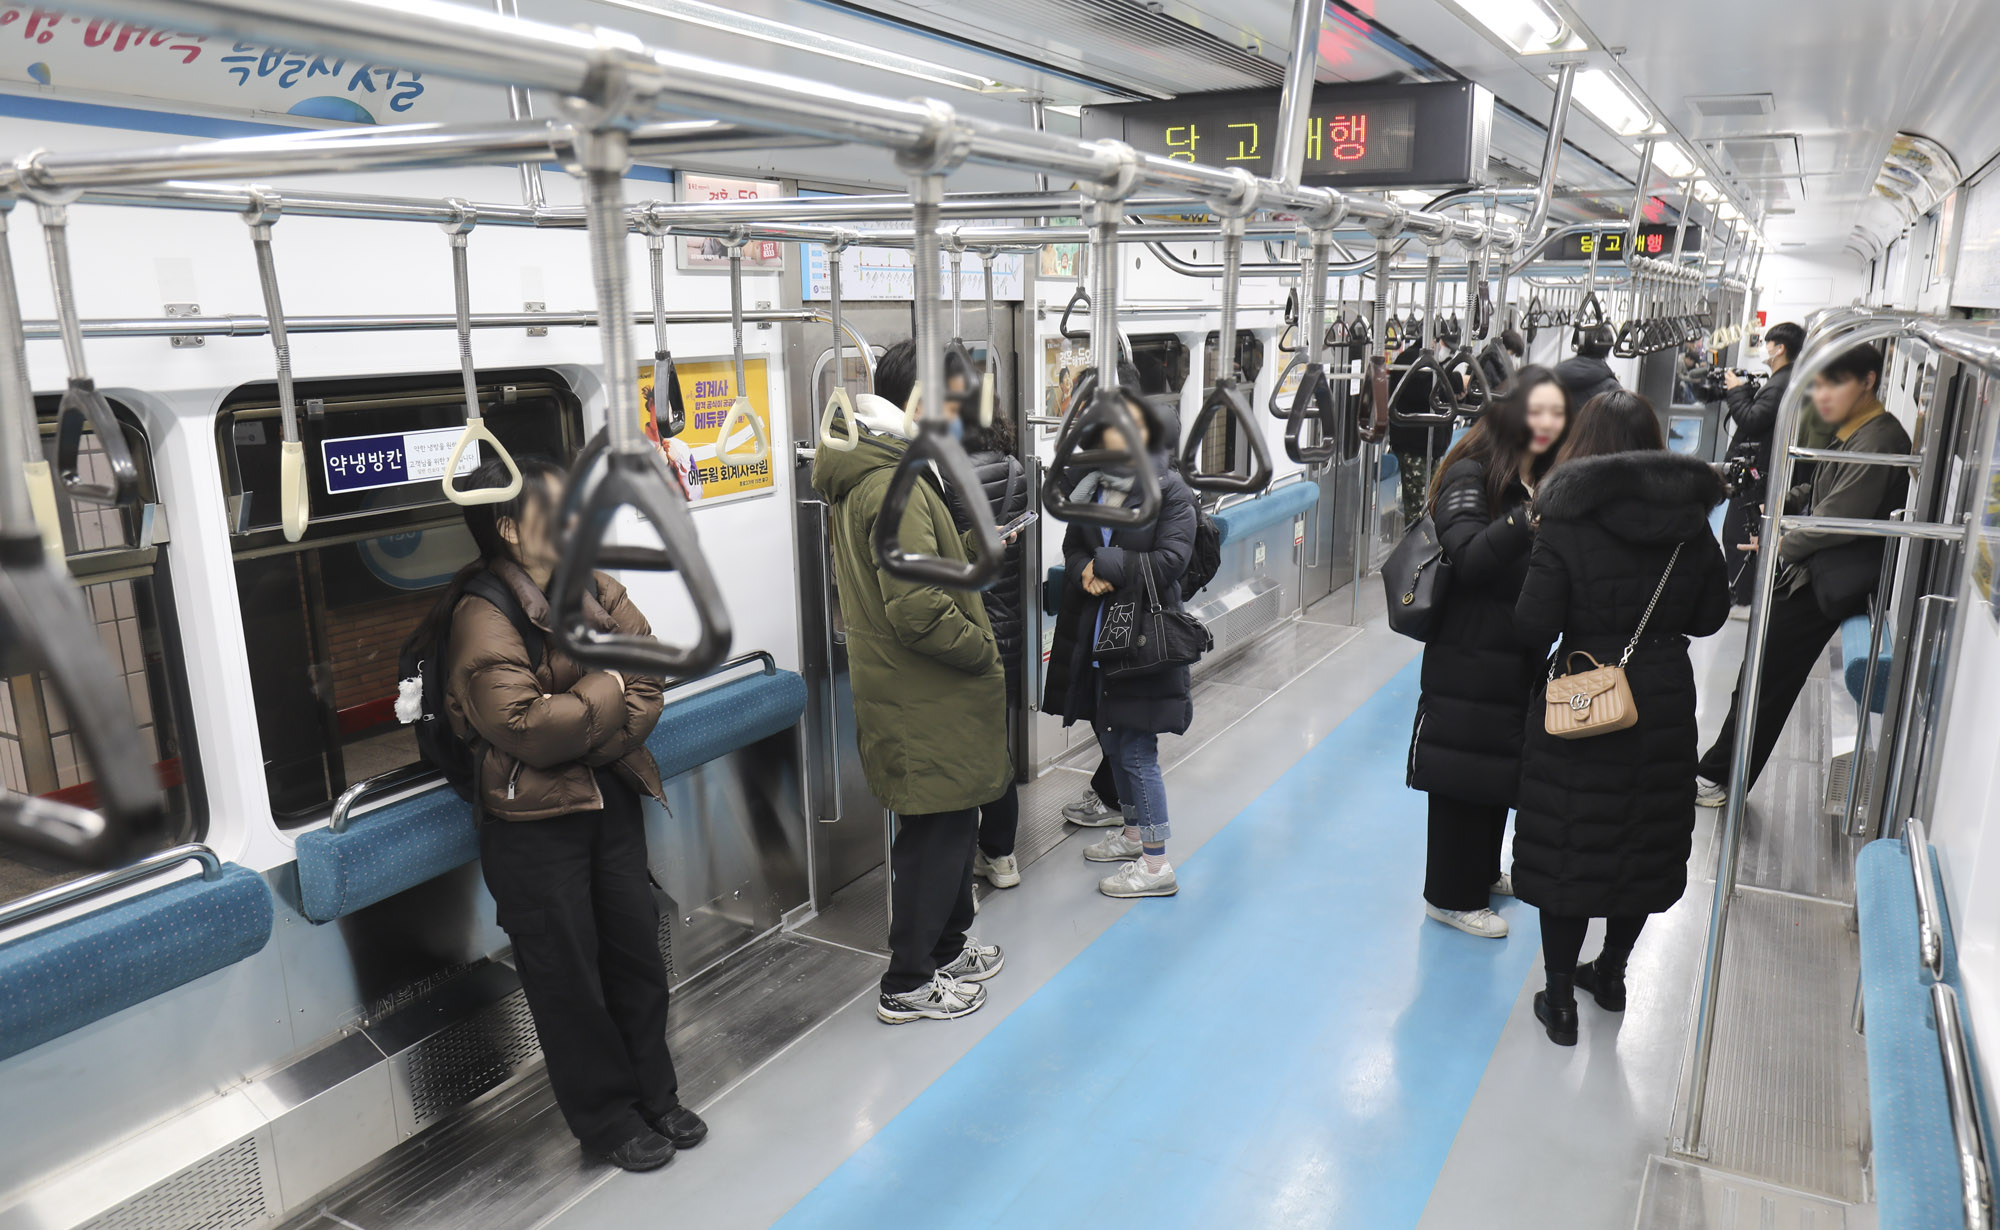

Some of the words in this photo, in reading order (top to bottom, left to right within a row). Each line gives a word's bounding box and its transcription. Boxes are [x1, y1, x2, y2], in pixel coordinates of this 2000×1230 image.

[695, 380, 728, 399] 회계사
[329, 448, 403, 476] 약냉방칸
[688, 466, 719, 486] 에듀윌
